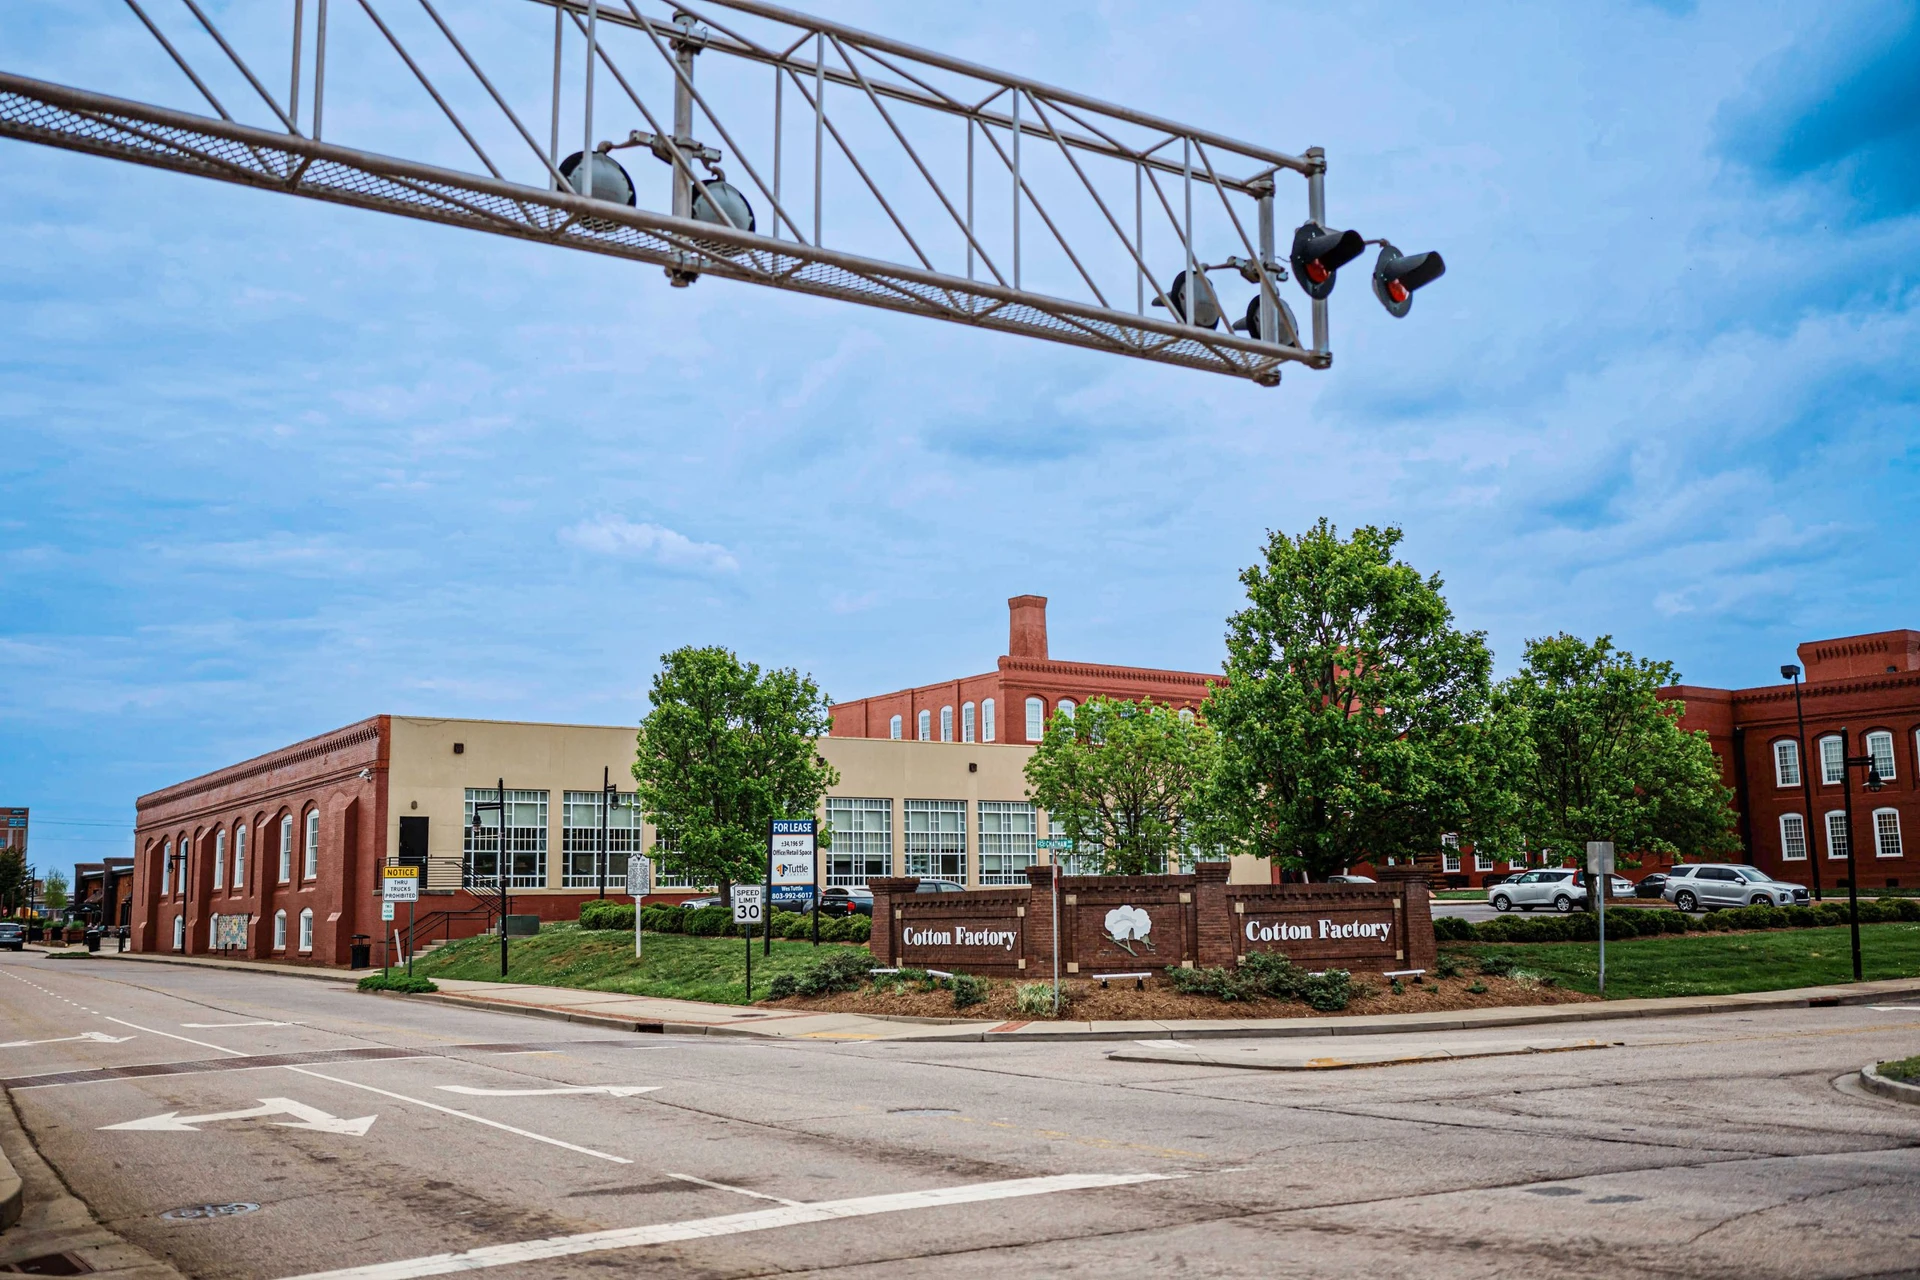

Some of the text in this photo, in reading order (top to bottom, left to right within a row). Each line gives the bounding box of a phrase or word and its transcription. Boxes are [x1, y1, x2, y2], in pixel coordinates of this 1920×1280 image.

[773, 823, 812, 832] FOR LEASE
[788, 864, 808, 873] Tuttle
[737, 904, 760, 919] 30
[1246, 919, 1392, 942] Cotton Factory
[903, 926, 1018, 951] Cotton Factory
